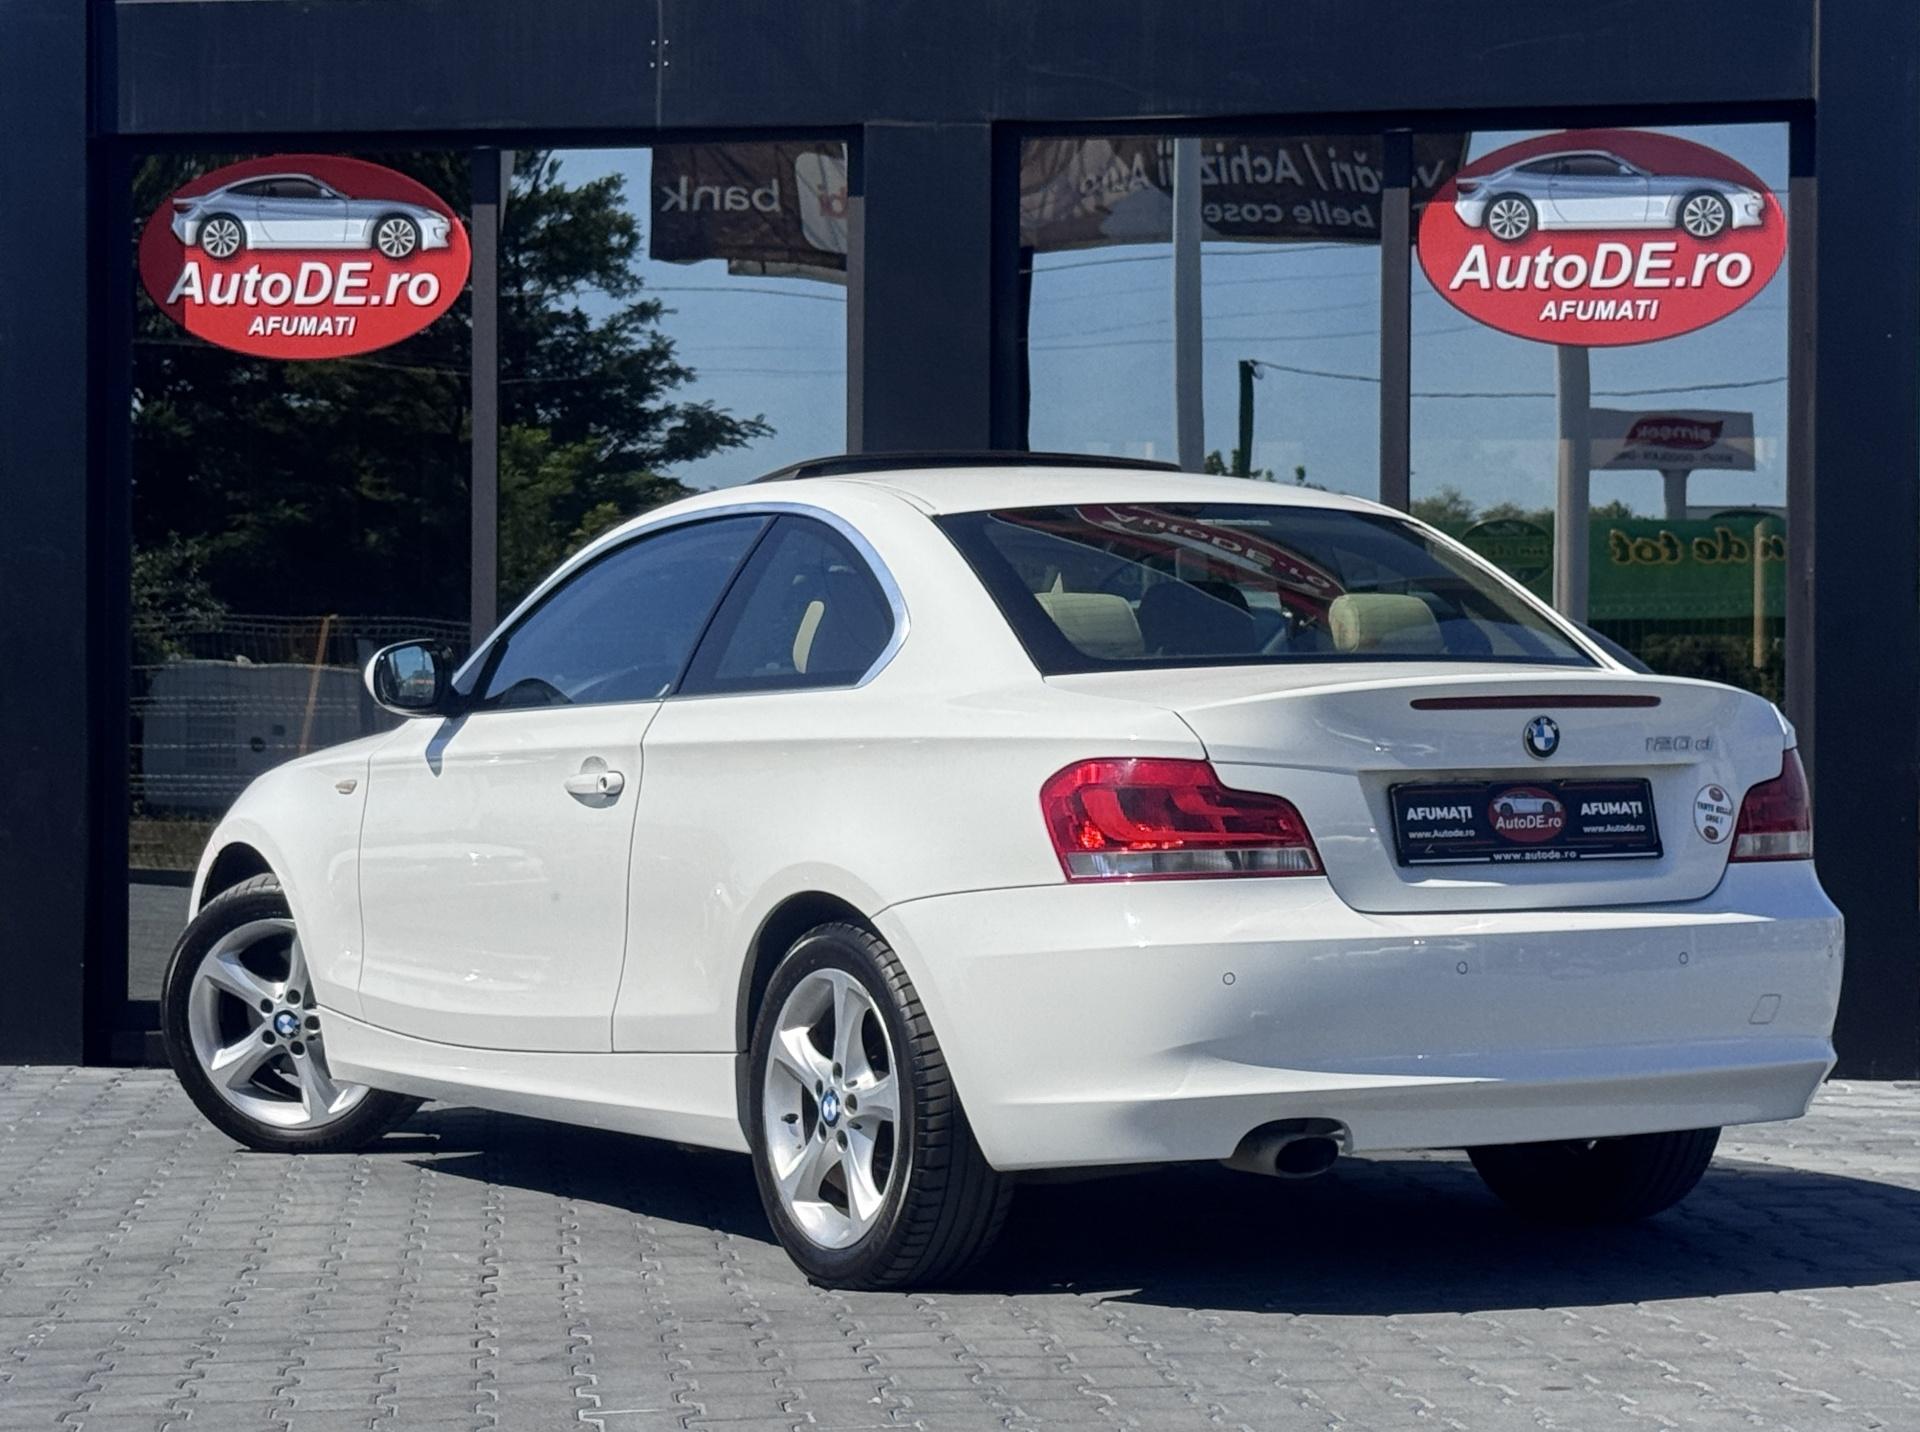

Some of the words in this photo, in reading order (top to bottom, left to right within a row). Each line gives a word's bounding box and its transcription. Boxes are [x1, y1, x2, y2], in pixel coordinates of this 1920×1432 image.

[1449, 241, 1753, 290] AutoDE.ro
[167, 261, 440, 307] AutoDE.ro
[1539, 299, 1660, 321] AFUMATI
[248, 316, 357, 337] AFUMATI
[1496, 815, 1562, 830] AutoDE.ro
[1583, 823, 1647, 834] www.Autode.ro
[1408, 829, 1476, 839] www.Autode.ro
[1493, 850, 1577, 861] www.autode.ro
